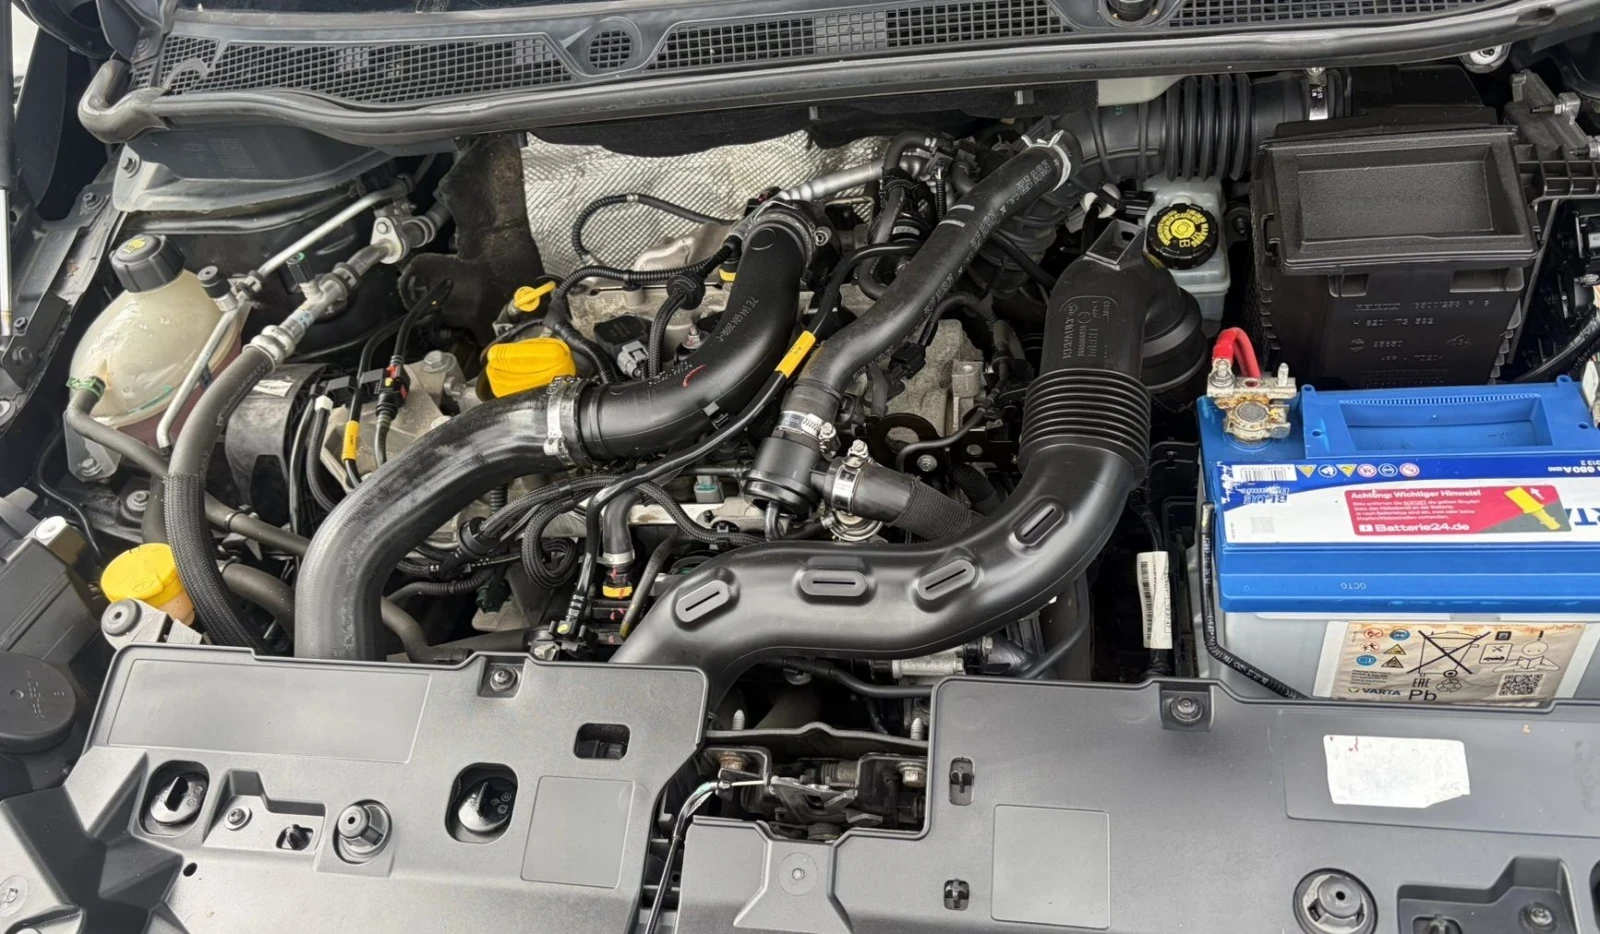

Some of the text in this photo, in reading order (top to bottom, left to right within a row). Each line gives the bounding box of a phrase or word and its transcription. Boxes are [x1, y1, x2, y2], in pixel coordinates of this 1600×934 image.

[1393, 490, 1438, 498] Wichtiger
[1374, 523, 1470, 532] Batterie24.de
[1408, 690, 1437, 700] Pb
